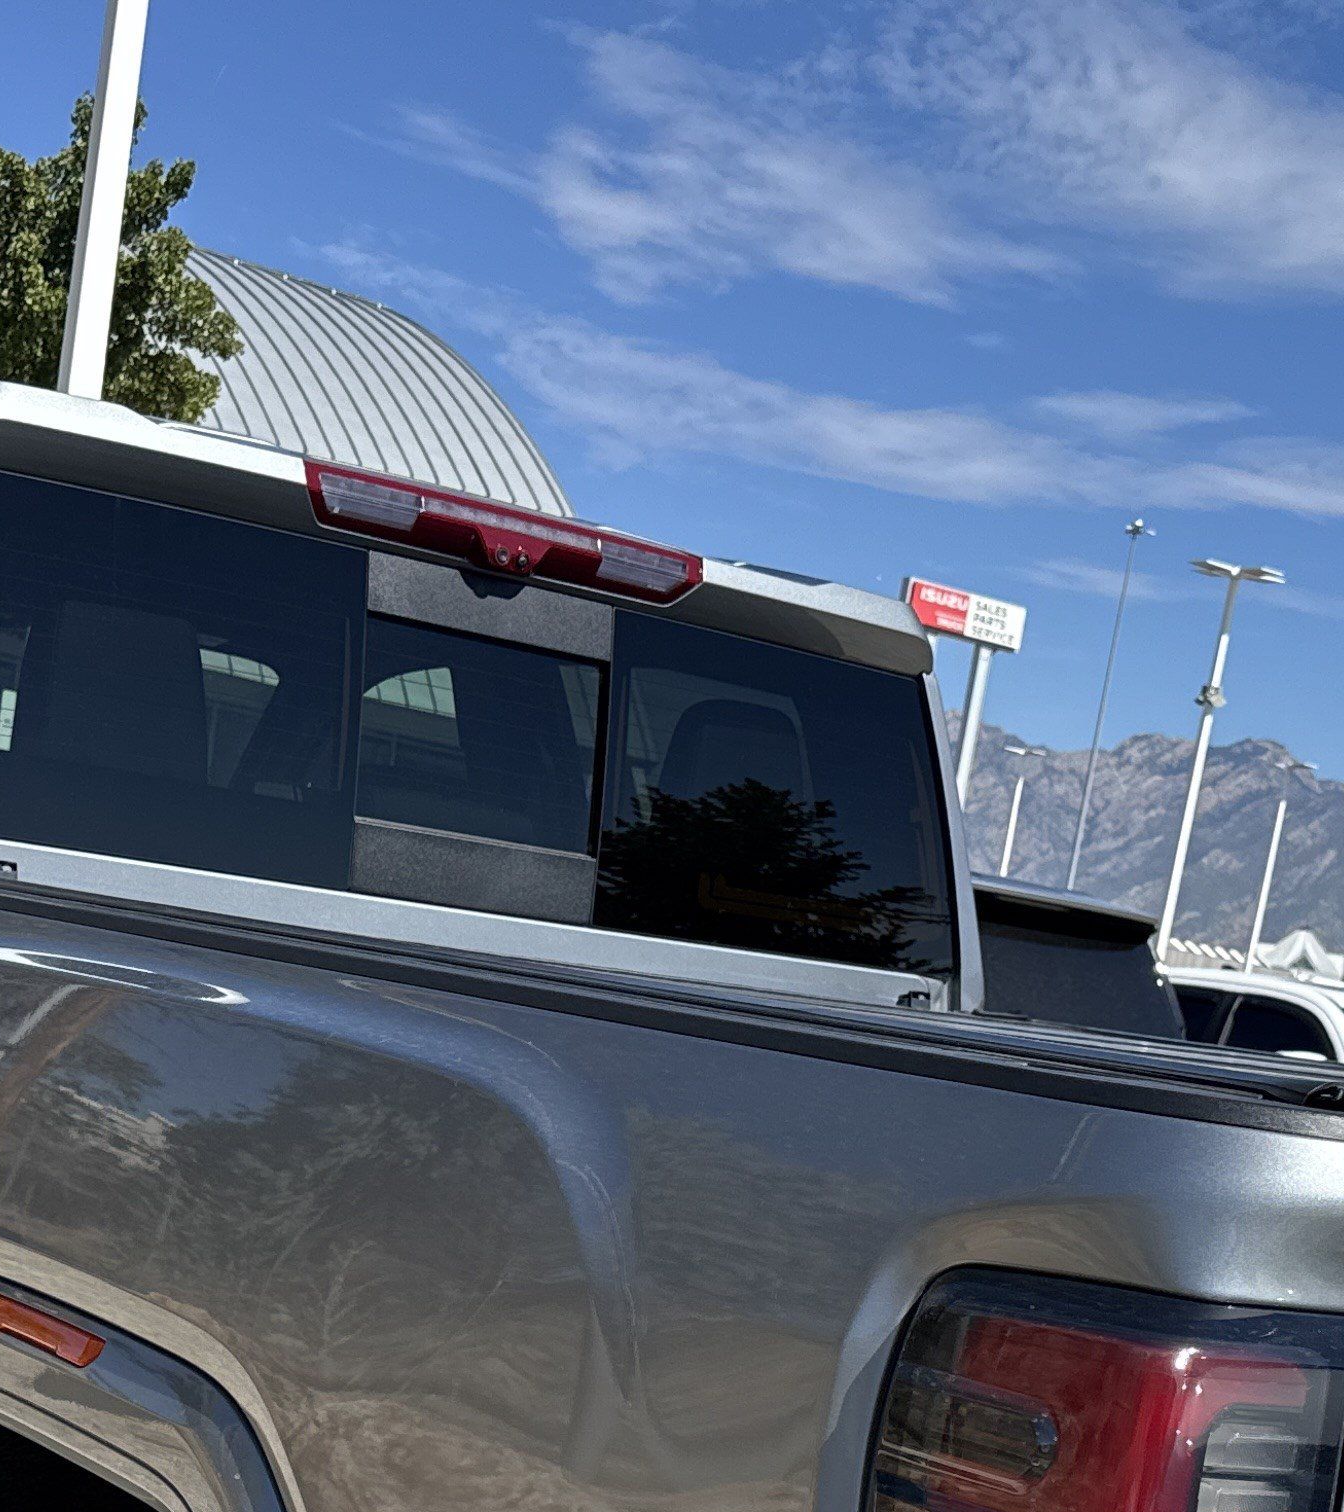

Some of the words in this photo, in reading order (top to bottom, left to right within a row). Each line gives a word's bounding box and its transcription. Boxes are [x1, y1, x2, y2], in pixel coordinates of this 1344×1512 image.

[920, 586, 969, 610] ISUZU
[975, 601, 1007, 617] SALES
[972, 613, 1006, 630] PARTS
[971, 625, 1015, 645] SERVICE
